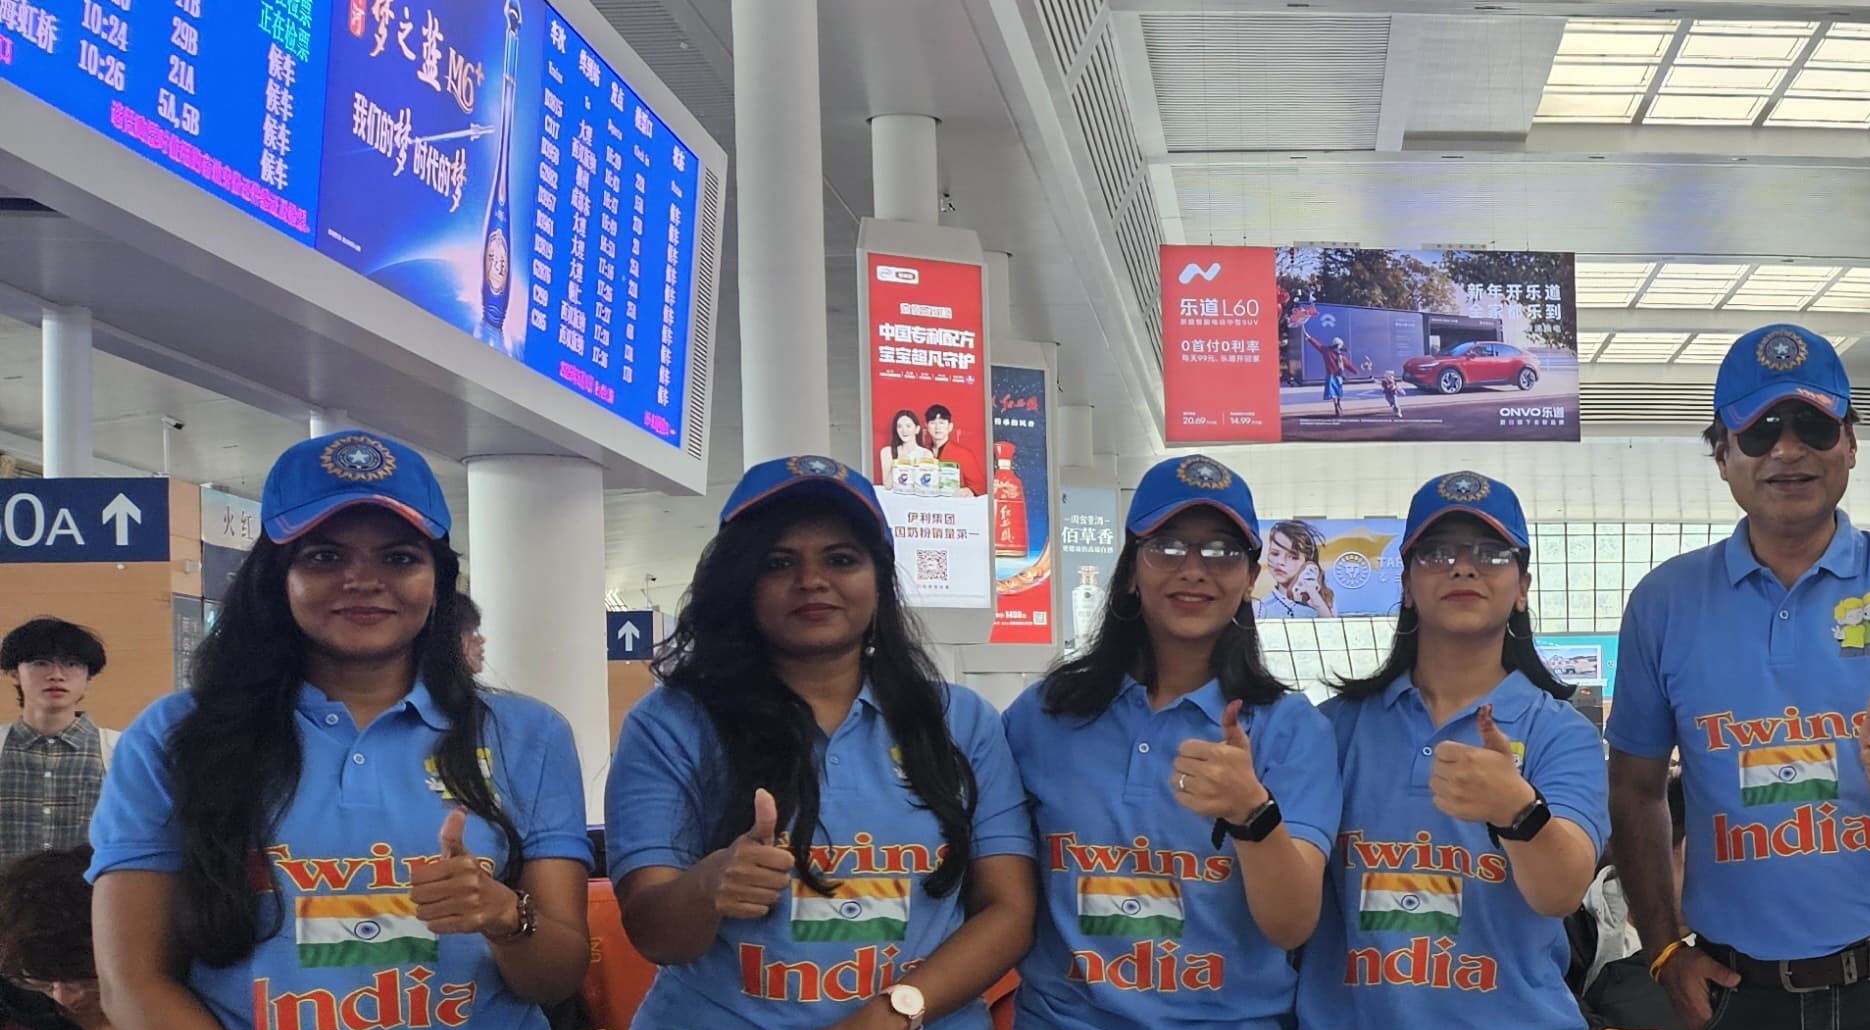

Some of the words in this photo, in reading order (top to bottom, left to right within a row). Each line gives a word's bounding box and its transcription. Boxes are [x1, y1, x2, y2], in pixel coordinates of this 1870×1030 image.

[81, 0, 129, 51] 10:24
[170, 15, 199, 56] 29B
[258, 1, 311, 63] 正在检票
[77, 39, 127, 91] 10:26
[167, 54, 195, 95] 21A
[267, 42, 296, 88] 候车
[265, 78, 294, 122] 候车
[262, 113, 291, 156] 候车
[352, 91, 412, 177] 我们的梦
[412, 136, 468, 213] 时代的梦
[260, 147, 288, 190] 候车
[1467, 283, 1562, 301] 新年开乐道
[1181, 339, 1261, 353] 0首付0利率
[0, 492, 86, 548] 0A
[893, 526, 980, 539] 国奶粉销量第一
[1045, 831, 1233, 883] Twins
[1067, 935, 1226, 993] ndia
[1343, 934, 1499, 993] ndia
